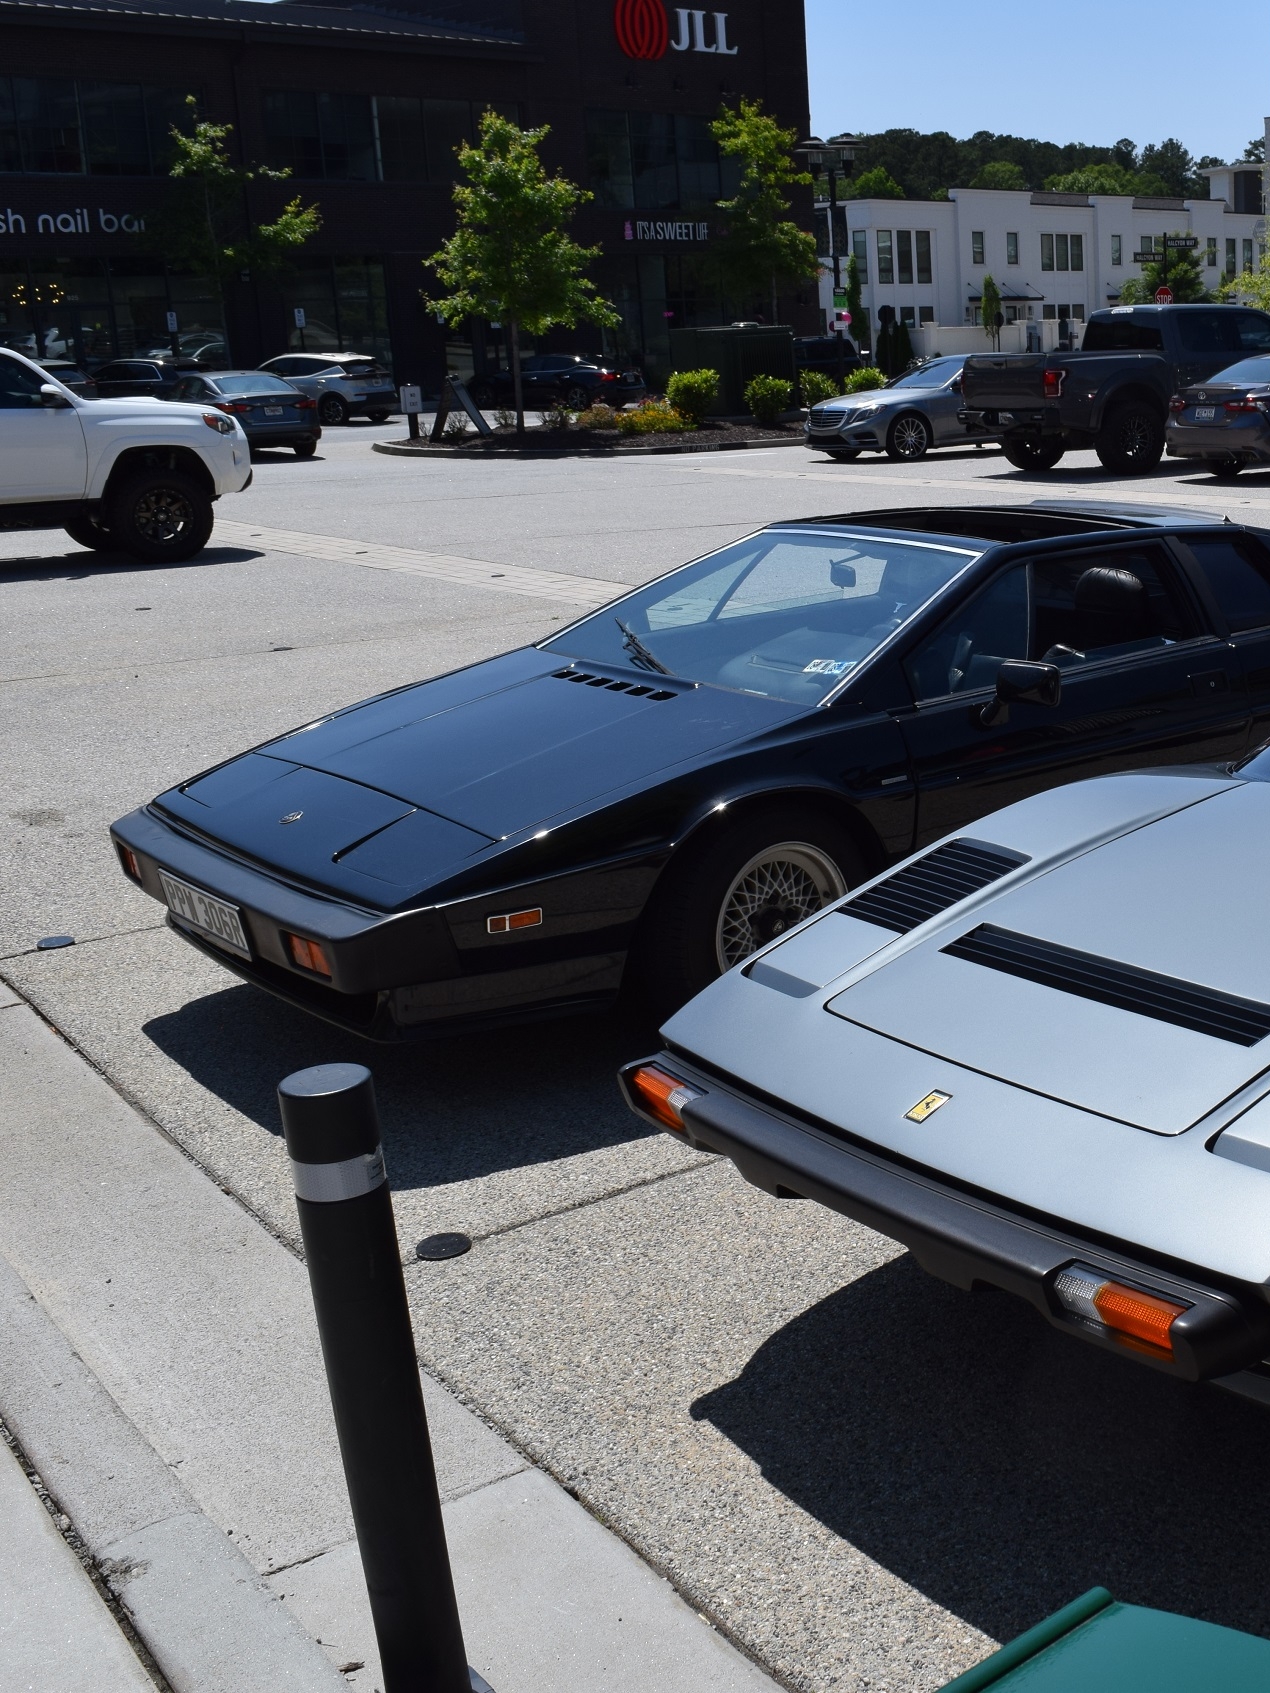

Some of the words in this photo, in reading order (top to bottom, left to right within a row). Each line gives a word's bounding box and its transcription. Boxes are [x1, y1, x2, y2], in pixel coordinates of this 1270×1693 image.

[670, 8, 738, 55] JLL
[38, 208, 90, 233] nail
[649, 221, 656, 240] A
[656, 221, 694, 240] SWEET
[1167, 239, 1186, 247] HALCYON
[1156, 295, 1172, 304] STOP
[692, 444, 720, 452] PARKING
[197, 896, 246, 948] 306R
